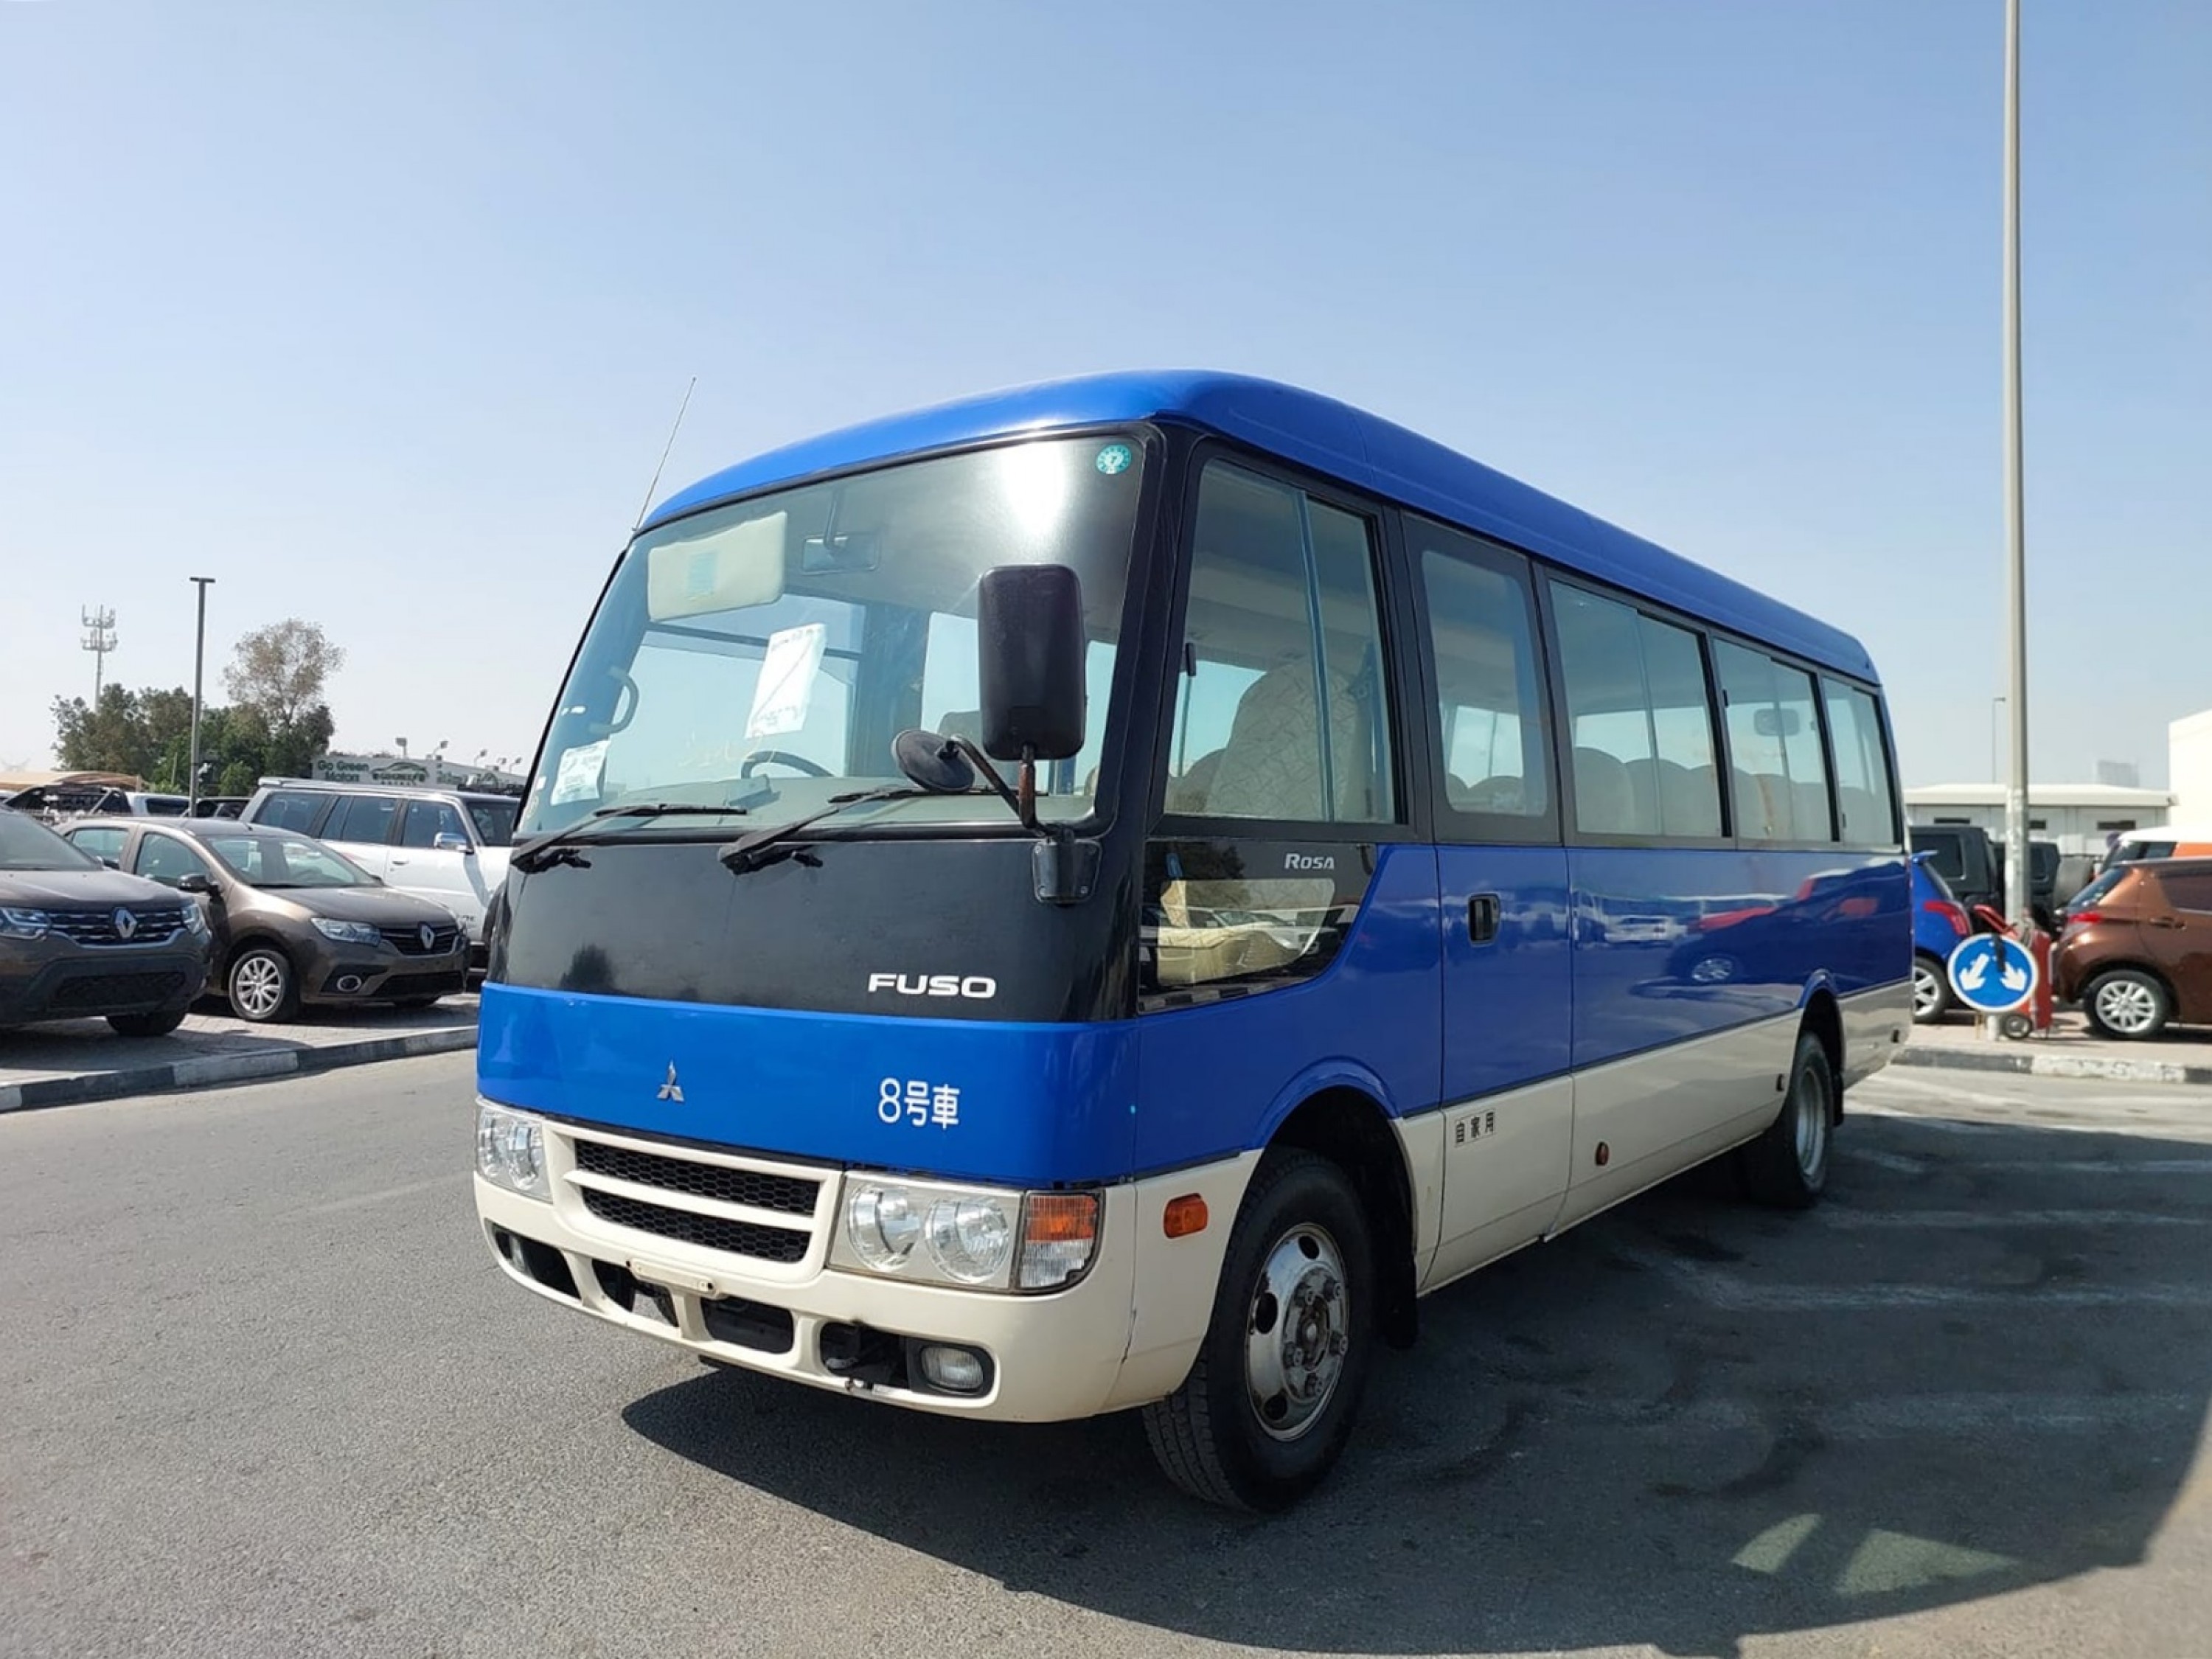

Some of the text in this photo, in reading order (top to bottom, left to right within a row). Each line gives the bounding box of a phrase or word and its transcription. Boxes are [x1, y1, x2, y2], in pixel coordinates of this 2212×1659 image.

[317, 759, 369, 772] Go Green
[868, 973, 996, 998] FUSO
[878, 1077, 960, 1130] 8号車
